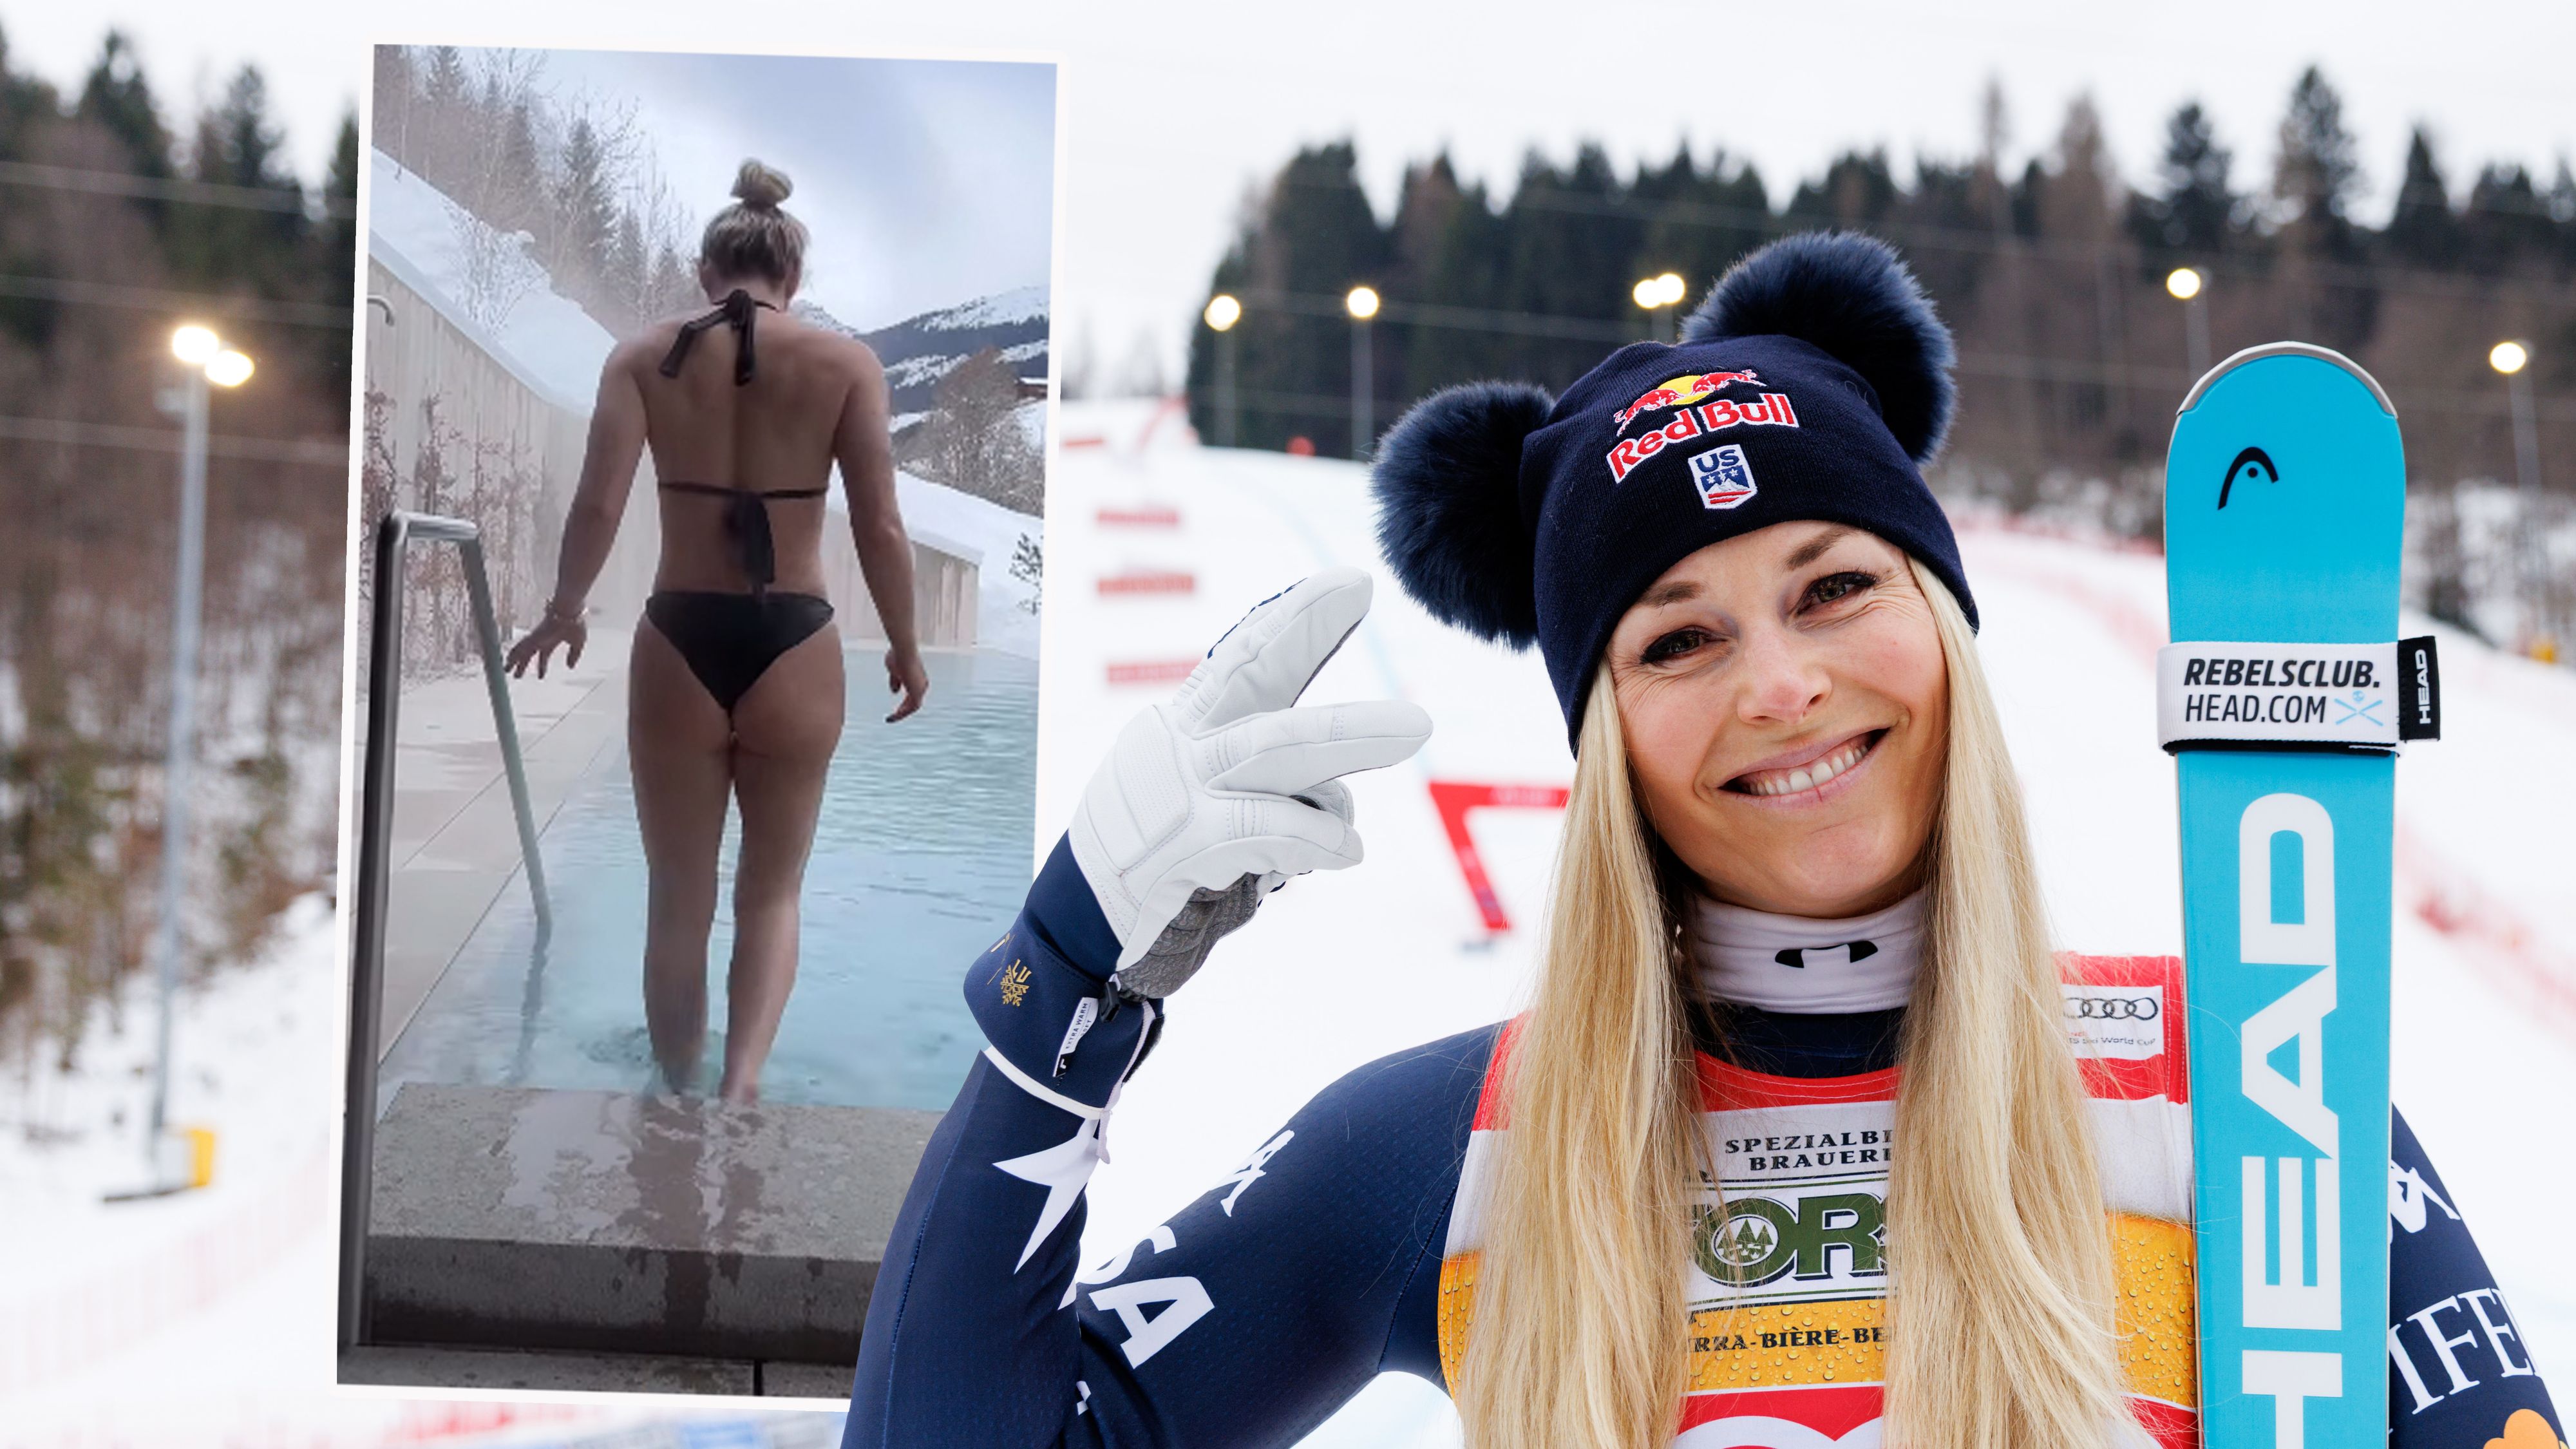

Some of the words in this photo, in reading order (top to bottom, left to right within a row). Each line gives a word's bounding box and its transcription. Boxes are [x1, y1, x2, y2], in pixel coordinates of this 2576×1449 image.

[1607, 409, 1701, 483] Red
[1701, 393, 1799, 431] Bull
[1696, 449, 1739, 473] US
[2184, 659, 2380, 688] REBELSCLUB.
[2415, 649, 2431, 724] HEAD
[2185, 694, 2326, 723] HEAD.COM
[1066, 1028, 1079, 1048] EXTRA
[1076, 1003, 1088, 1026] WARM
[1725, 1130, 1892, 1153] SPEZIALBI
[2239, 793, 2342, 1449] HEAD
[1076, 1225, 1215, 1369] SA
[2389, 1287, 2539, 1414] IFE
